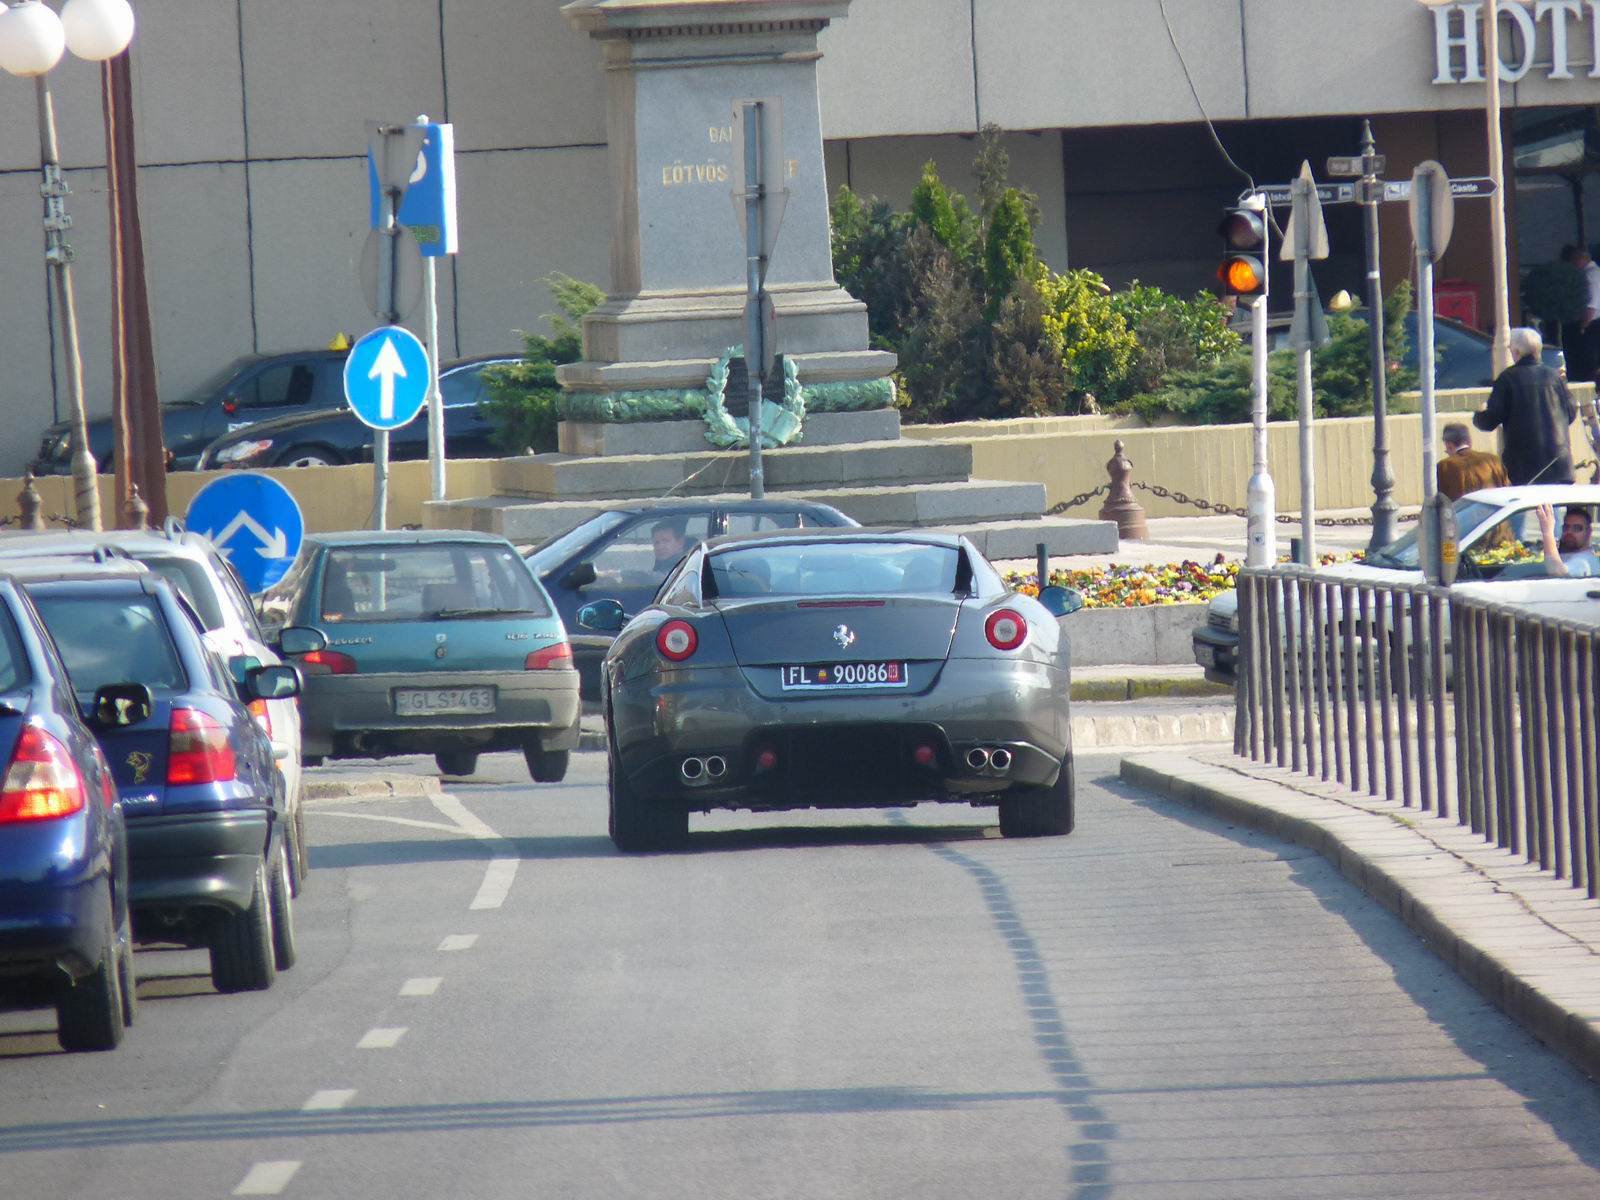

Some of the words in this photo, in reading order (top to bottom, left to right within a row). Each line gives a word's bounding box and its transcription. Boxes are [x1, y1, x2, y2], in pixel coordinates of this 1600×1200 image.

[1451, 183, 1479, 193] Castle
[789, 665, 812, 684] FL
[833, 662, 888, 684] 90086
